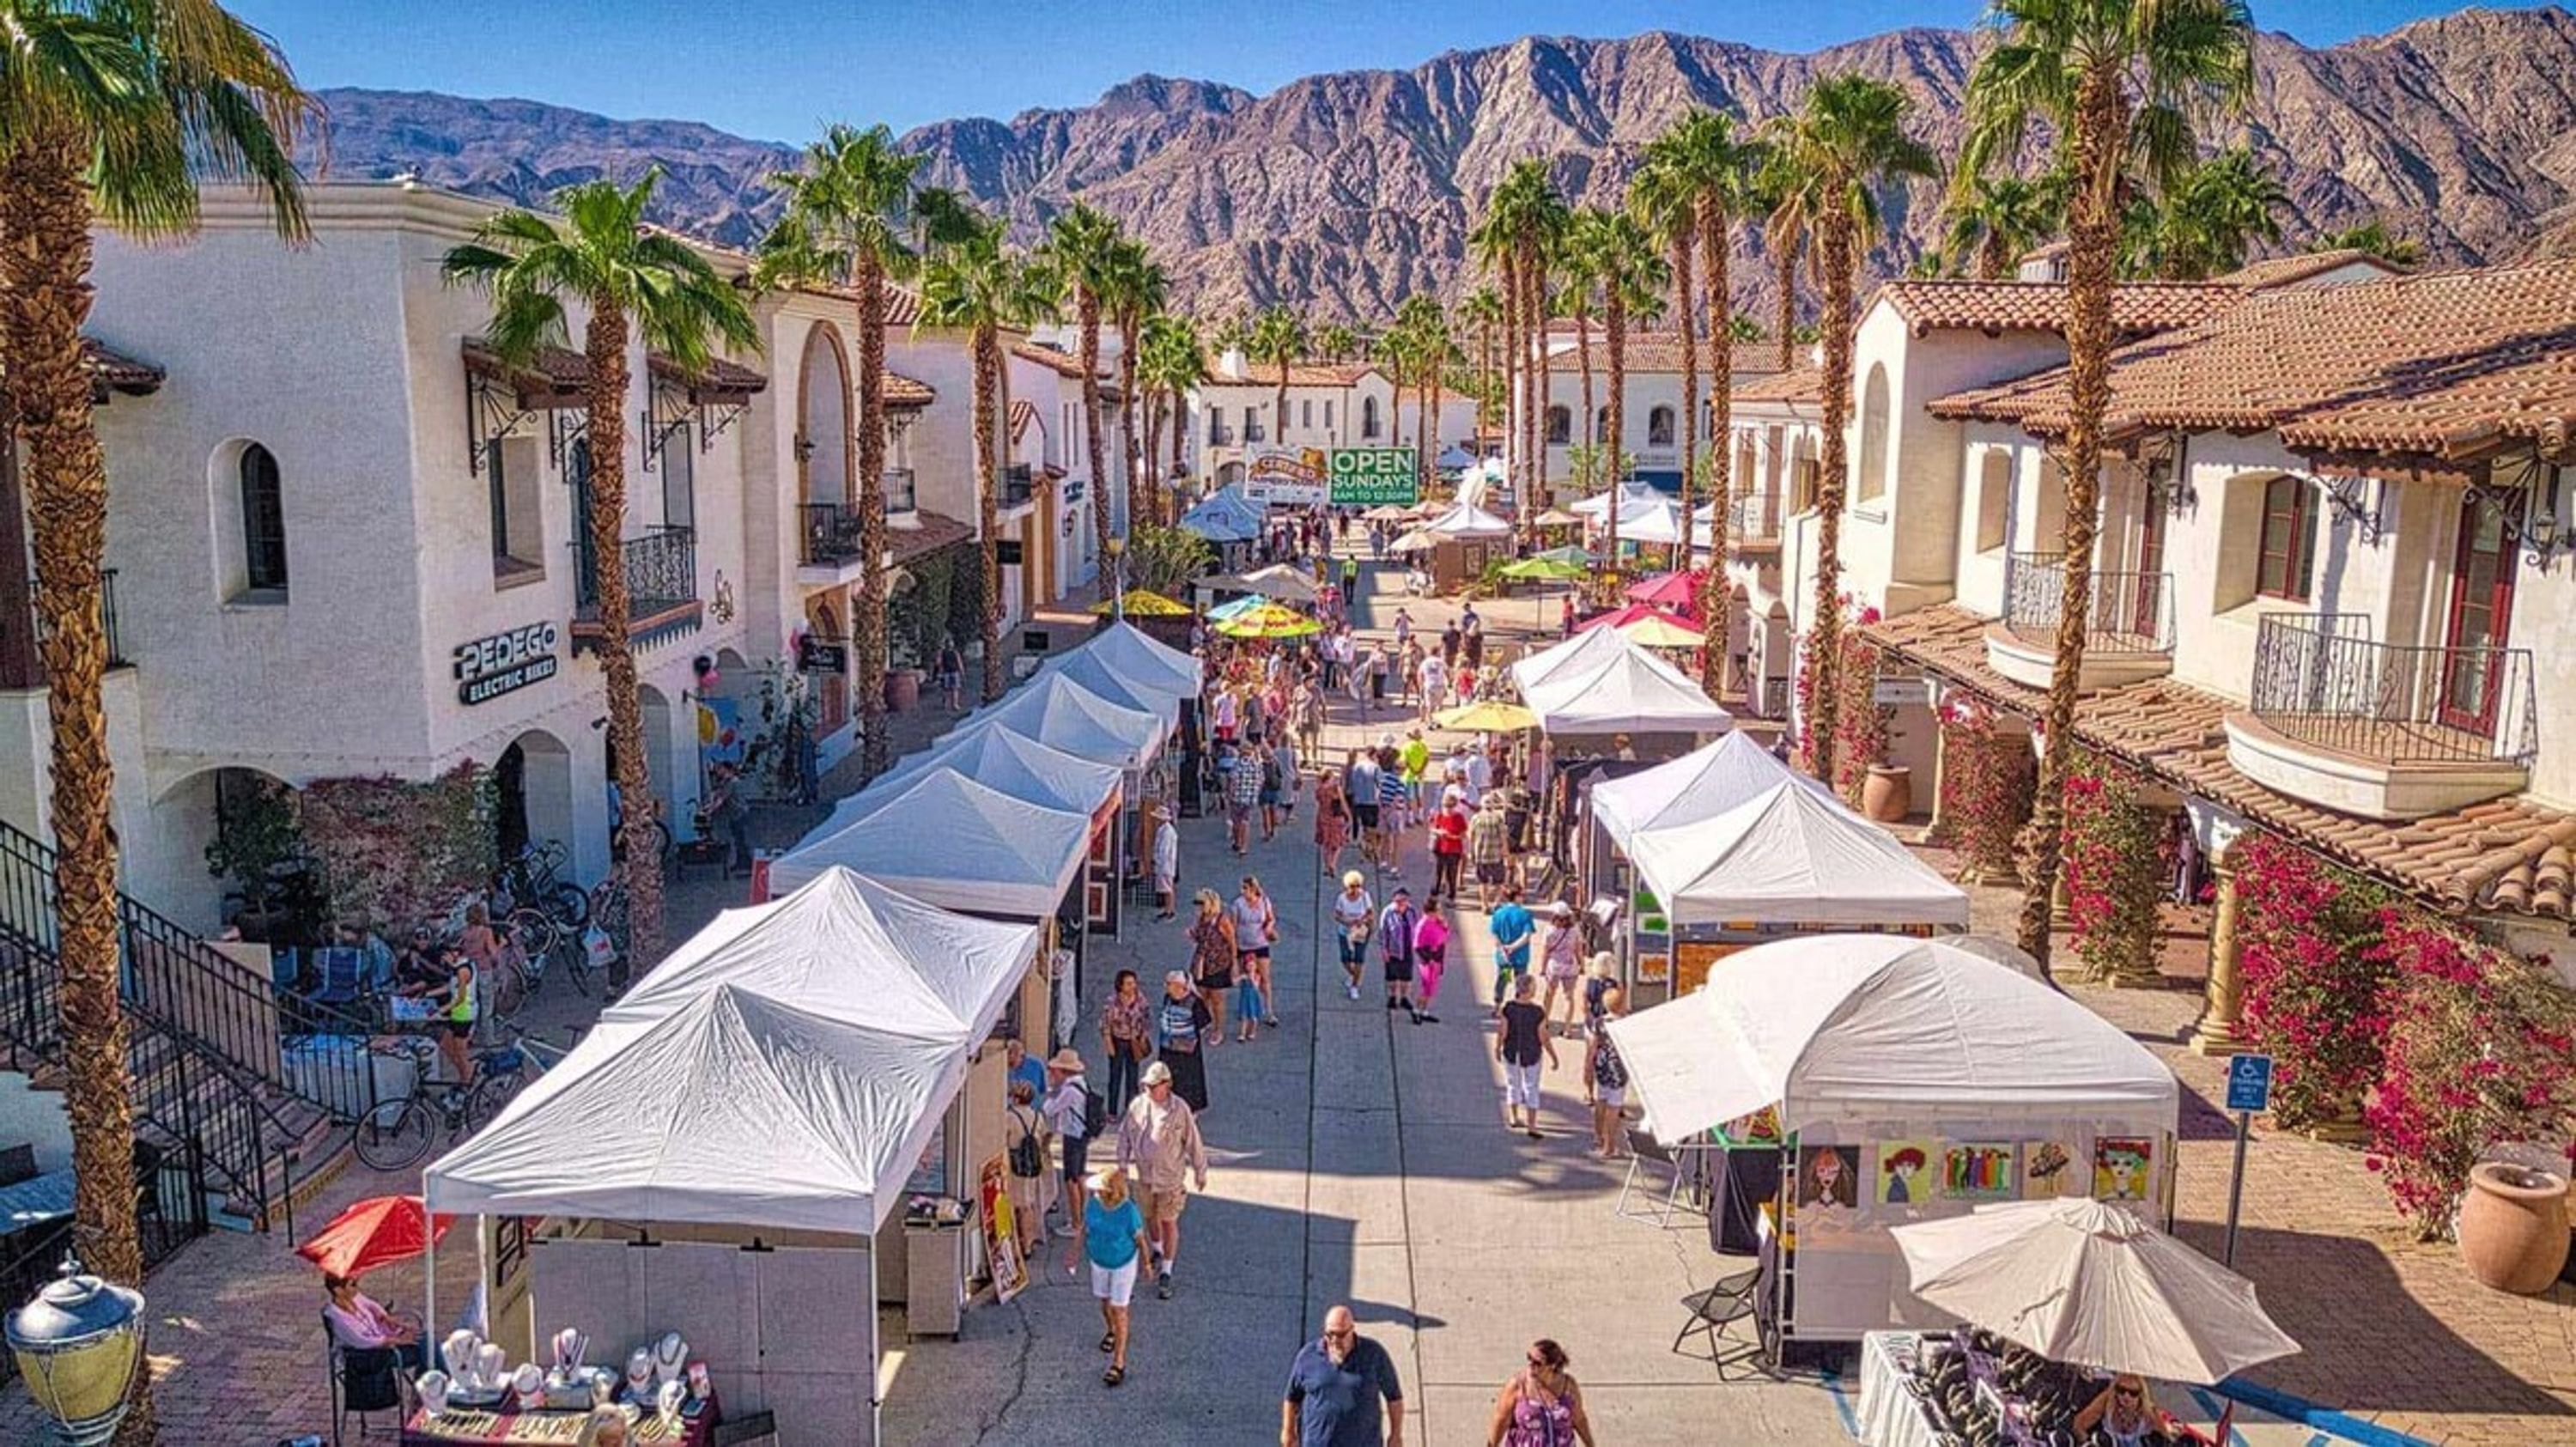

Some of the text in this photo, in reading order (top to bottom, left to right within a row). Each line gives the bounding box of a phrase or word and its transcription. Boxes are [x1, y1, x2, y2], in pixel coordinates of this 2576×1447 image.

[1334, 450, 1413, 473] OPEN
[1333, 473, 1413, 489] SUNDAYS
[1358, 491, 1371, 500] TO
[459, 621, 557, 679] PEDEGO
[469, 658, 555, 701] ELECTRIC BIKES
